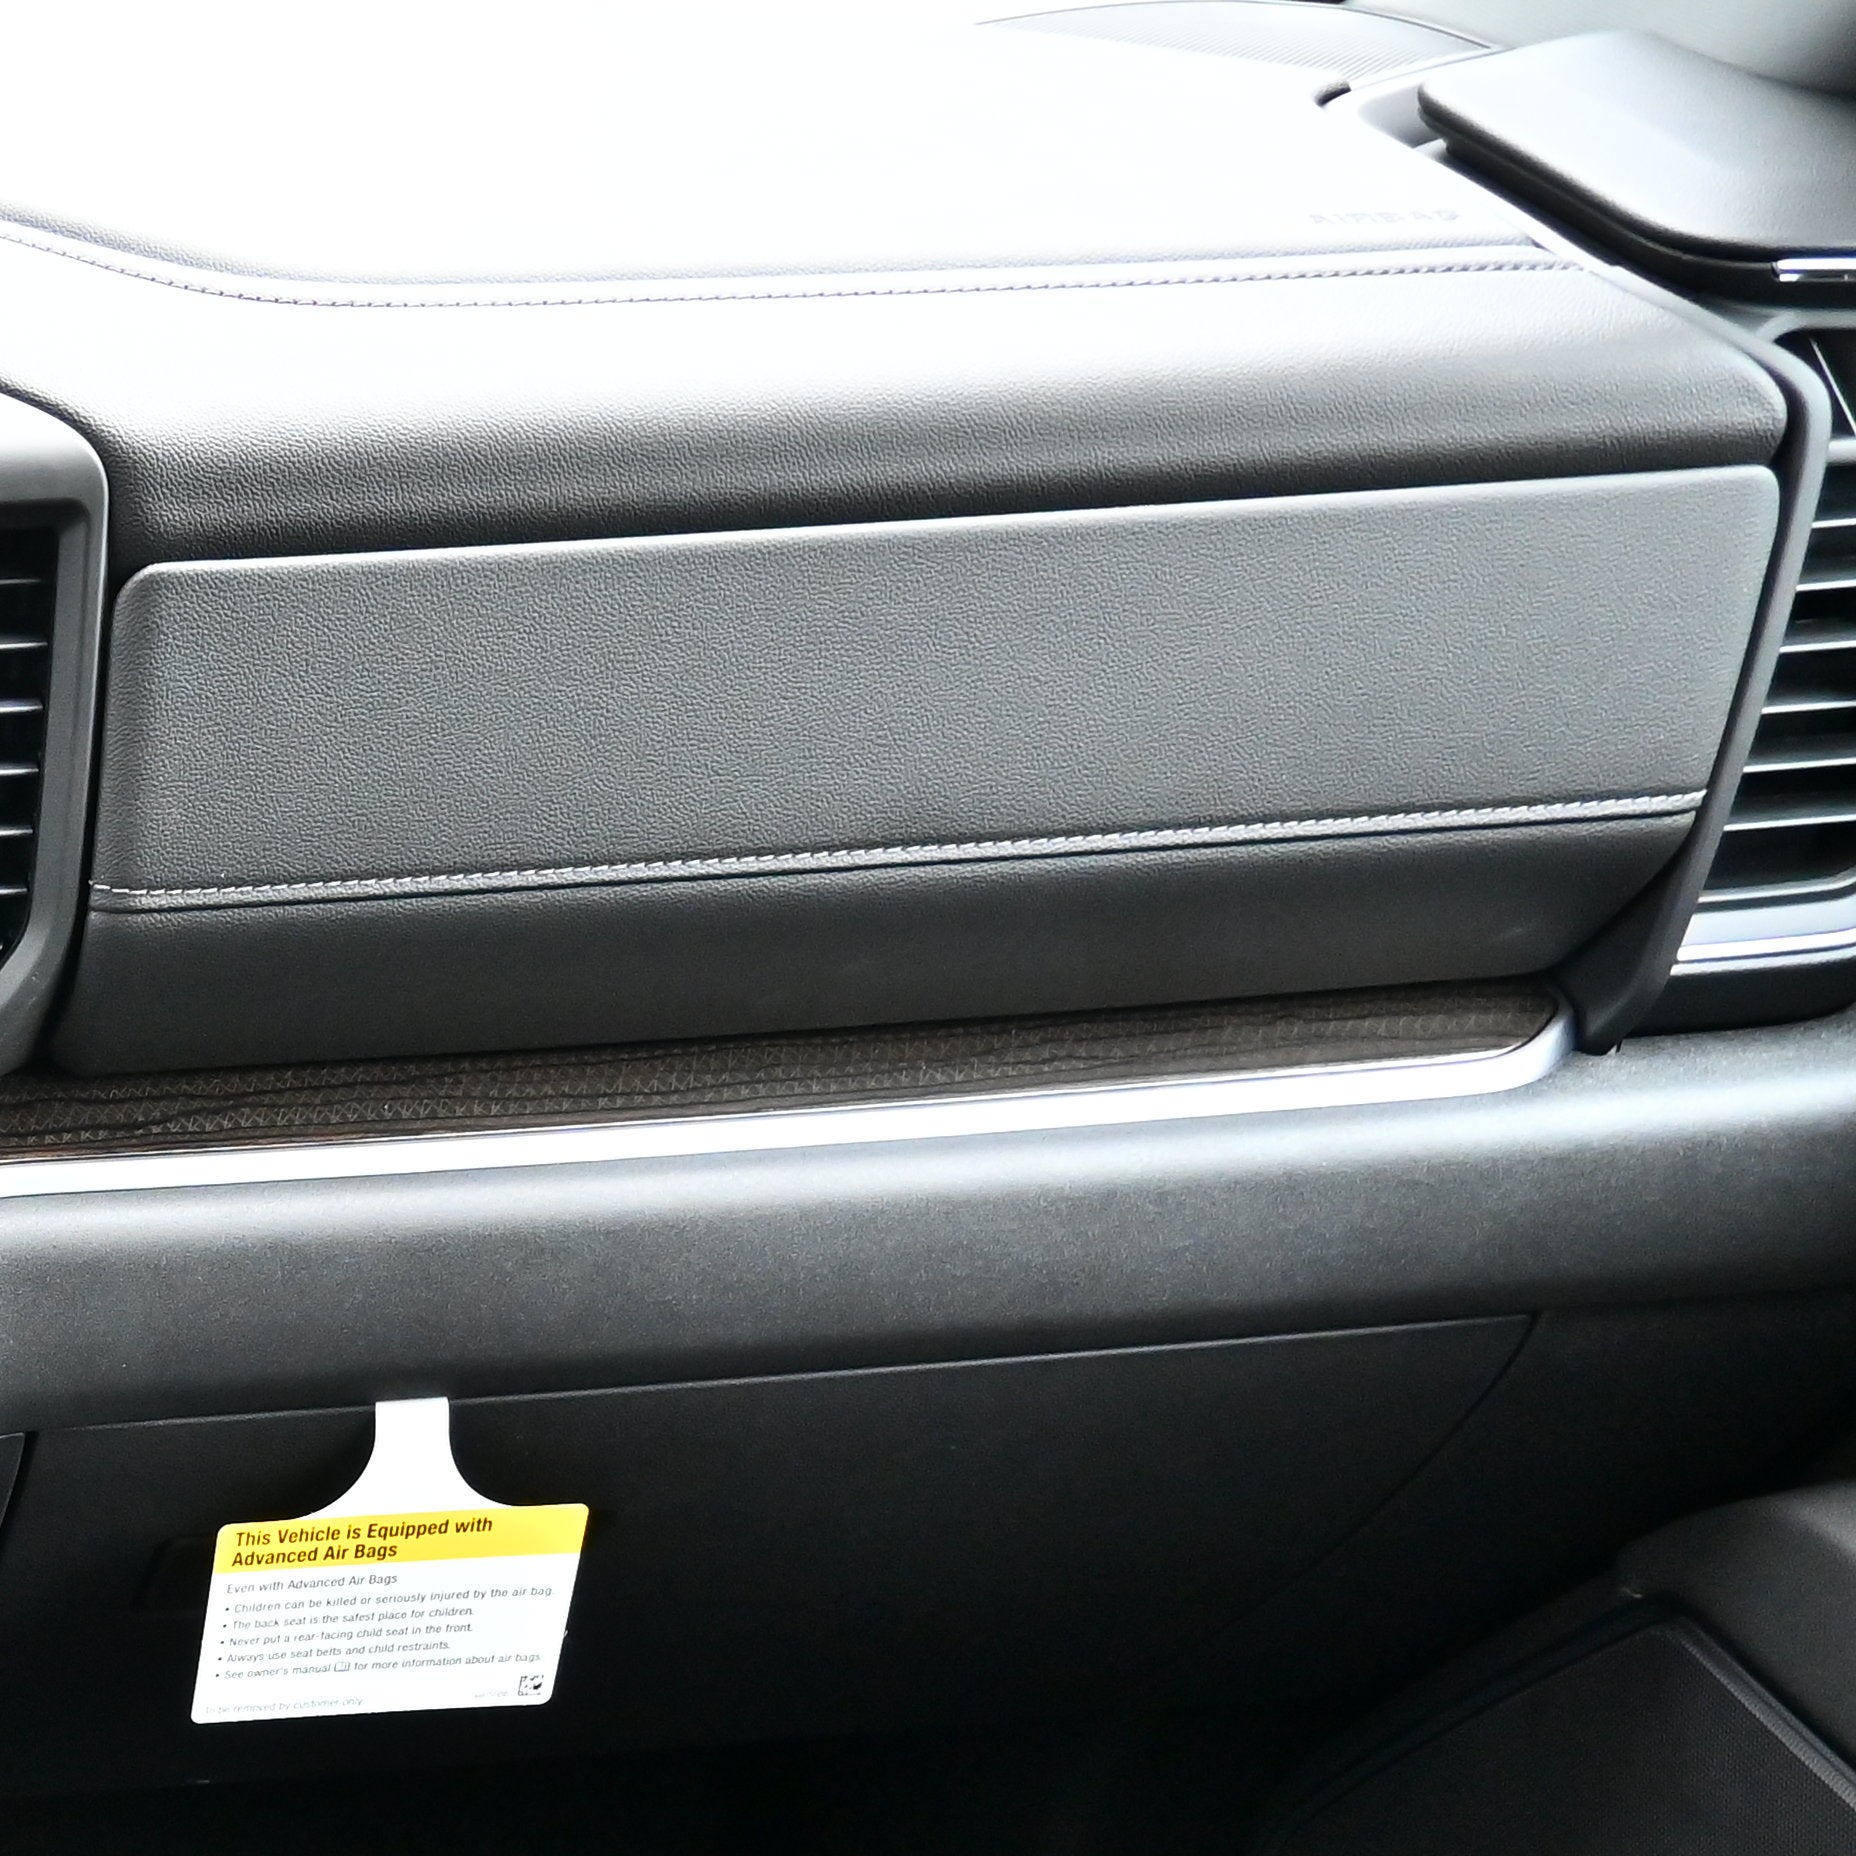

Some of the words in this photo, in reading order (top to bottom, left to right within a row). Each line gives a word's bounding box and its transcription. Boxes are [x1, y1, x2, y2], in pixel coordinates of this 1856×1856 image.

[236, 1530, 271, 1547] This
[278, 1526, 340, 1544] Vehicle
[346, 1524, 361, 1540] is
[367, 1519, 450, 1541] Equipped
[455, 1517, 493, 1533] with
[231, 1547, 318, 1567] Advanced
[323, 1545, 349, 1561] Air
[354, 1544, 398, 1561] Bags
[226, 1583, 255, 1594] Even
[259, 1581, 284, 1592] with
[287, 1577, 346, 1590] Advanced
[348, 1575, 365, 1587] Air
[369, 1574, 398, 1586] Bags
[234, 1601, 281, 1613] Children
[284, 1600, 305, 1610] can
[308, 1598, 322, 1608] be
[326, 1596, 357, 1607] killed
[360, 1596, 371, 1605] or
[375, 1592, 426, 1604] seriously
[430, 1590, 470, 1602] injured
[473, 1589, 487, 1599] by
[490, 1588, 509, 1597] the
[512, 1587, 527, 1596] air
[254, 1618, 279, 1629] back
[283, 1616, 306, 1626] seat
[310, 1615, 319, 1624] is
[322, 1614, 339, 1623] the
[342, 1611, 376, 1622] safest
[378, 1610, 407, 1622] place
[410, 1609, 425, 1619] for
[229, 1637, 260, 1647] Never
[262, 1635, 281, 1645] put
[294, 1630, 353, 1642] rear-facing
[356, 1627, 383, 1638] child
[386, 1625, 408, 1636] seat
[412, 1624, 421, 1634] in
[425, 1624, 442, 1634] the
[227, 1653, 265, 1664] Always
[268, 1652, 286, 1660] use
[290, 1648, 313, 1658] seat
[316, 1646, 342, 1657] belts
[345, 1645, 365, 1655] and
[368, 1643, 394, 1654] child
[224, 1670, 243, 1679] See
[292, 1662, 331, 1675] manual
[354, 1661, 368, 1670] for
[371, 1660, 398, 1669] more
[401, 1657, 462, 1669] information
[465, 1654, 495, 1664] about
[498, 1653, 512, 1663] air
